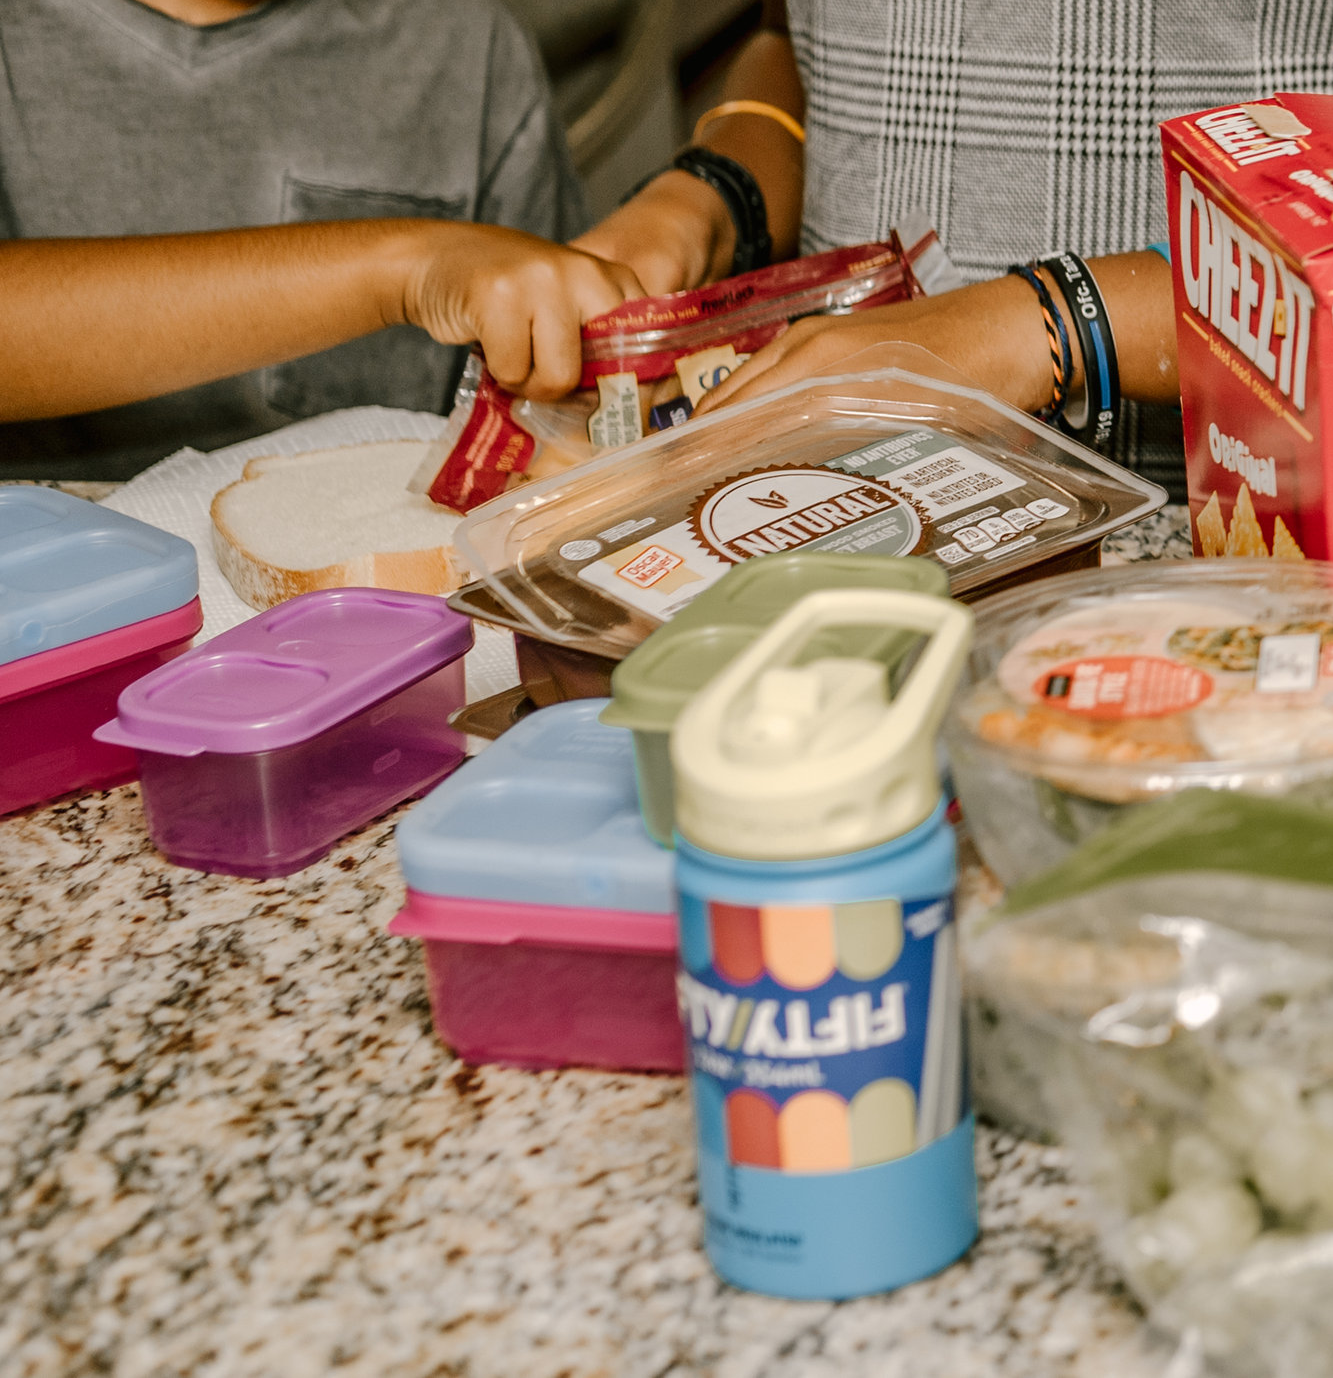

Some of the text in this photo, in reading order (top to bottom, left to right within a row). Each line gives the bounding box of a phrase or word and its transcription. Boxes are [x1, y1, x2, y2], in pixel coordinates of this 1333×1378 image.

[1076, 281, 1098, 320] Ofc.
[843, 431, 935, 469] NO ANTIBIOTICS
[908, 464, 966, 489] INGREDIENTS
[914, 456, 961, 479] ARTIFICIAL
[925, 488, 943, 500] NO
[940, 477, 976, 496] NITRITES
[933, 477, 1004, 508] NITRATES ADDED
[732, 489, 892, 558] NATURAL
[849, 516, 898, 540] SMOKED
[962, 529, 979, 541] 70
[854, 525, 904, 554] BREAST
[627, 550, 660, 576] Oscar
[635, 555, 673, 583] Mayer
